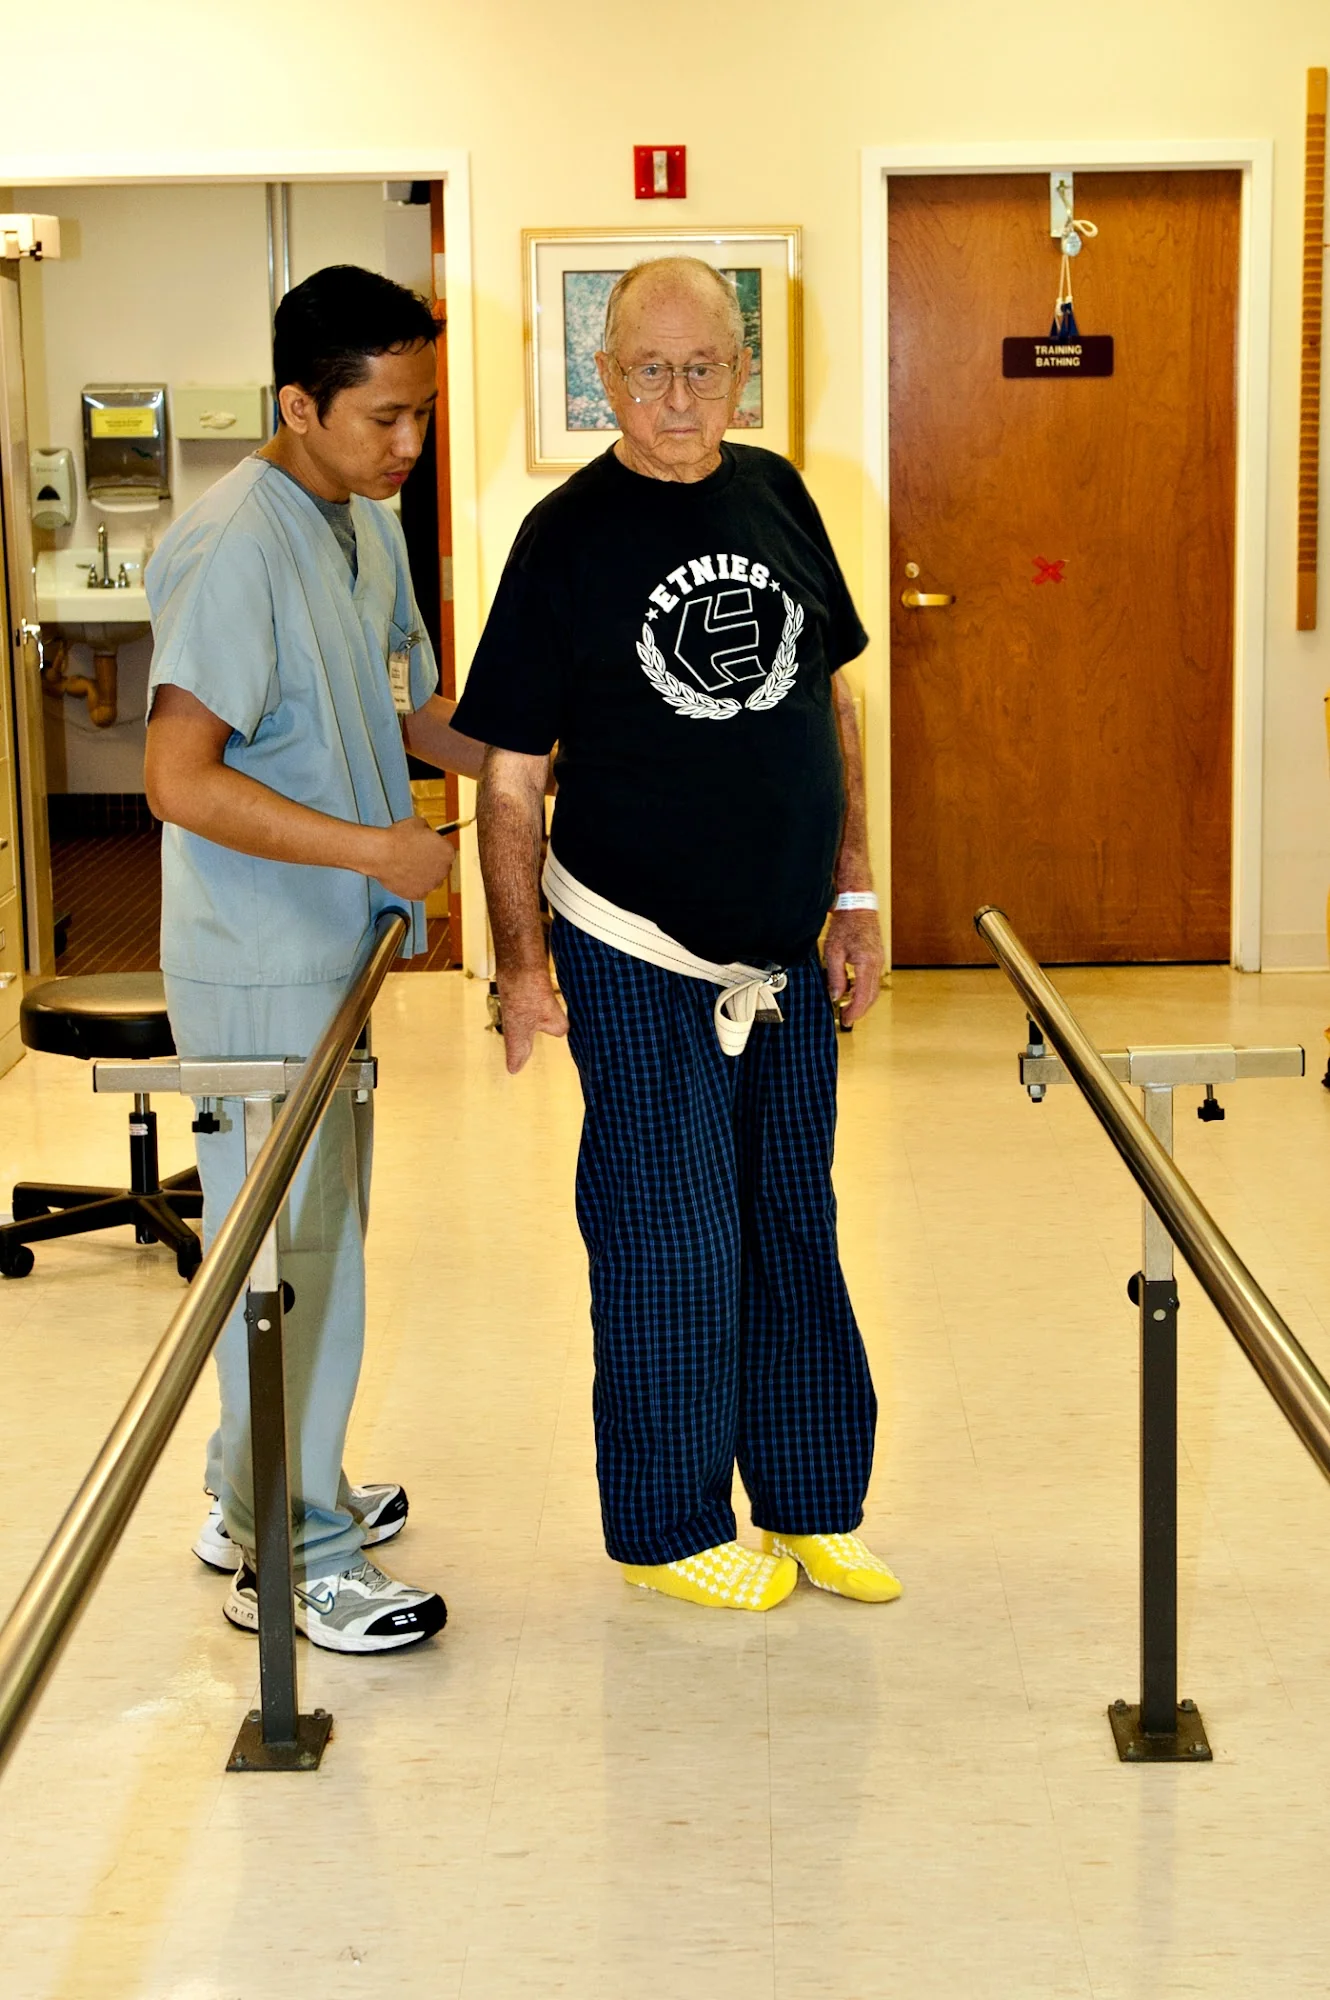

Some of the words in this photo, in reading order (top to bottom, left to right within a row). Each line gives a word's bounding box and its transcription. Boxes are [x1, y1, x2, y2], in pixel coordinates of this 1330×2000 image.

[1035, 345, 1082, 355] TRAINING
[1036, 357, 1080, 367] BATHING
[648, 553, 771, 614] ETNIES
